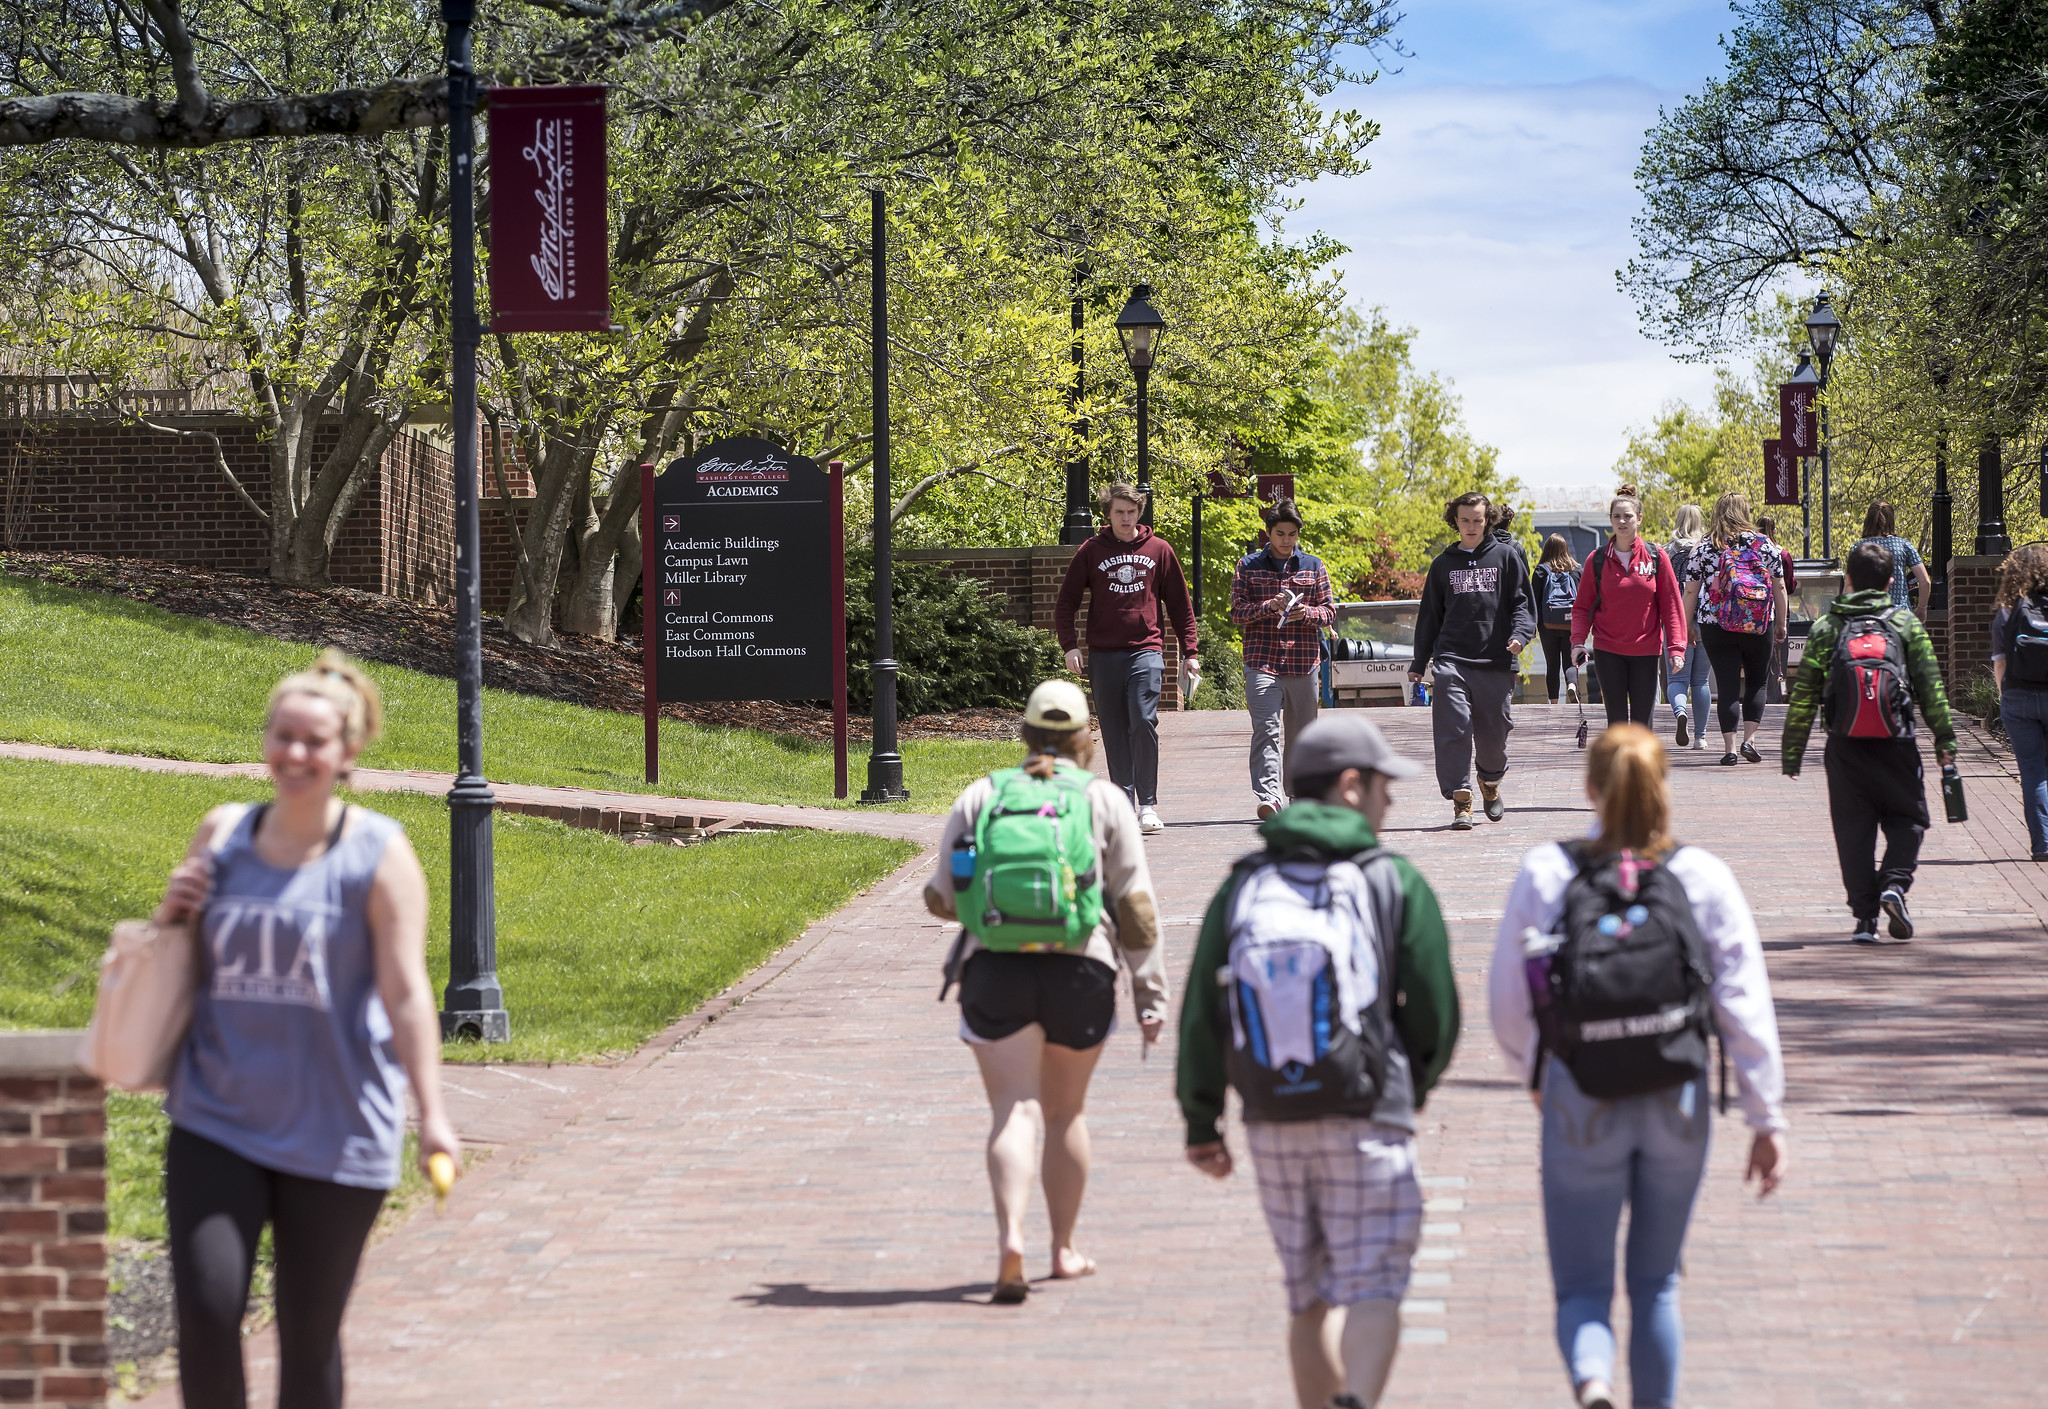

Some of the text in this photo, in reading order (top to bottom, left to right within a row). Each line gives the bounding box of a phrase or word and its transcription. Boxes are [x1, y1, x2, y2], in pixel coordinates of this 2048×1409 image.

[564, 118, 576, 298] WASHINGTON COLLEGE
[706, 485, 779, 497] ACADEMICS
[664, 537, 779, 553] Academic Buildings
[664, 555, 749, 570] Campus Lawn
[1098, 555, 1156, 571] WASHINGTON
[665, 571, 747, 586] Miller Library
[1449, 568, 1497, 584] SHOREMEN
[1109, 581, 1145, 593] COLLEGE
[1454, 582, 1494, 594] SOCCER
[665, 611, 774, 624] Central Commons
[665, 628, 755, 641] East Commons
[666, 644, 807, 658] Hodson Hall Commons
[1788, 641, 1804, 650] Car
[1366, 663, 1405, 672] Club Car
